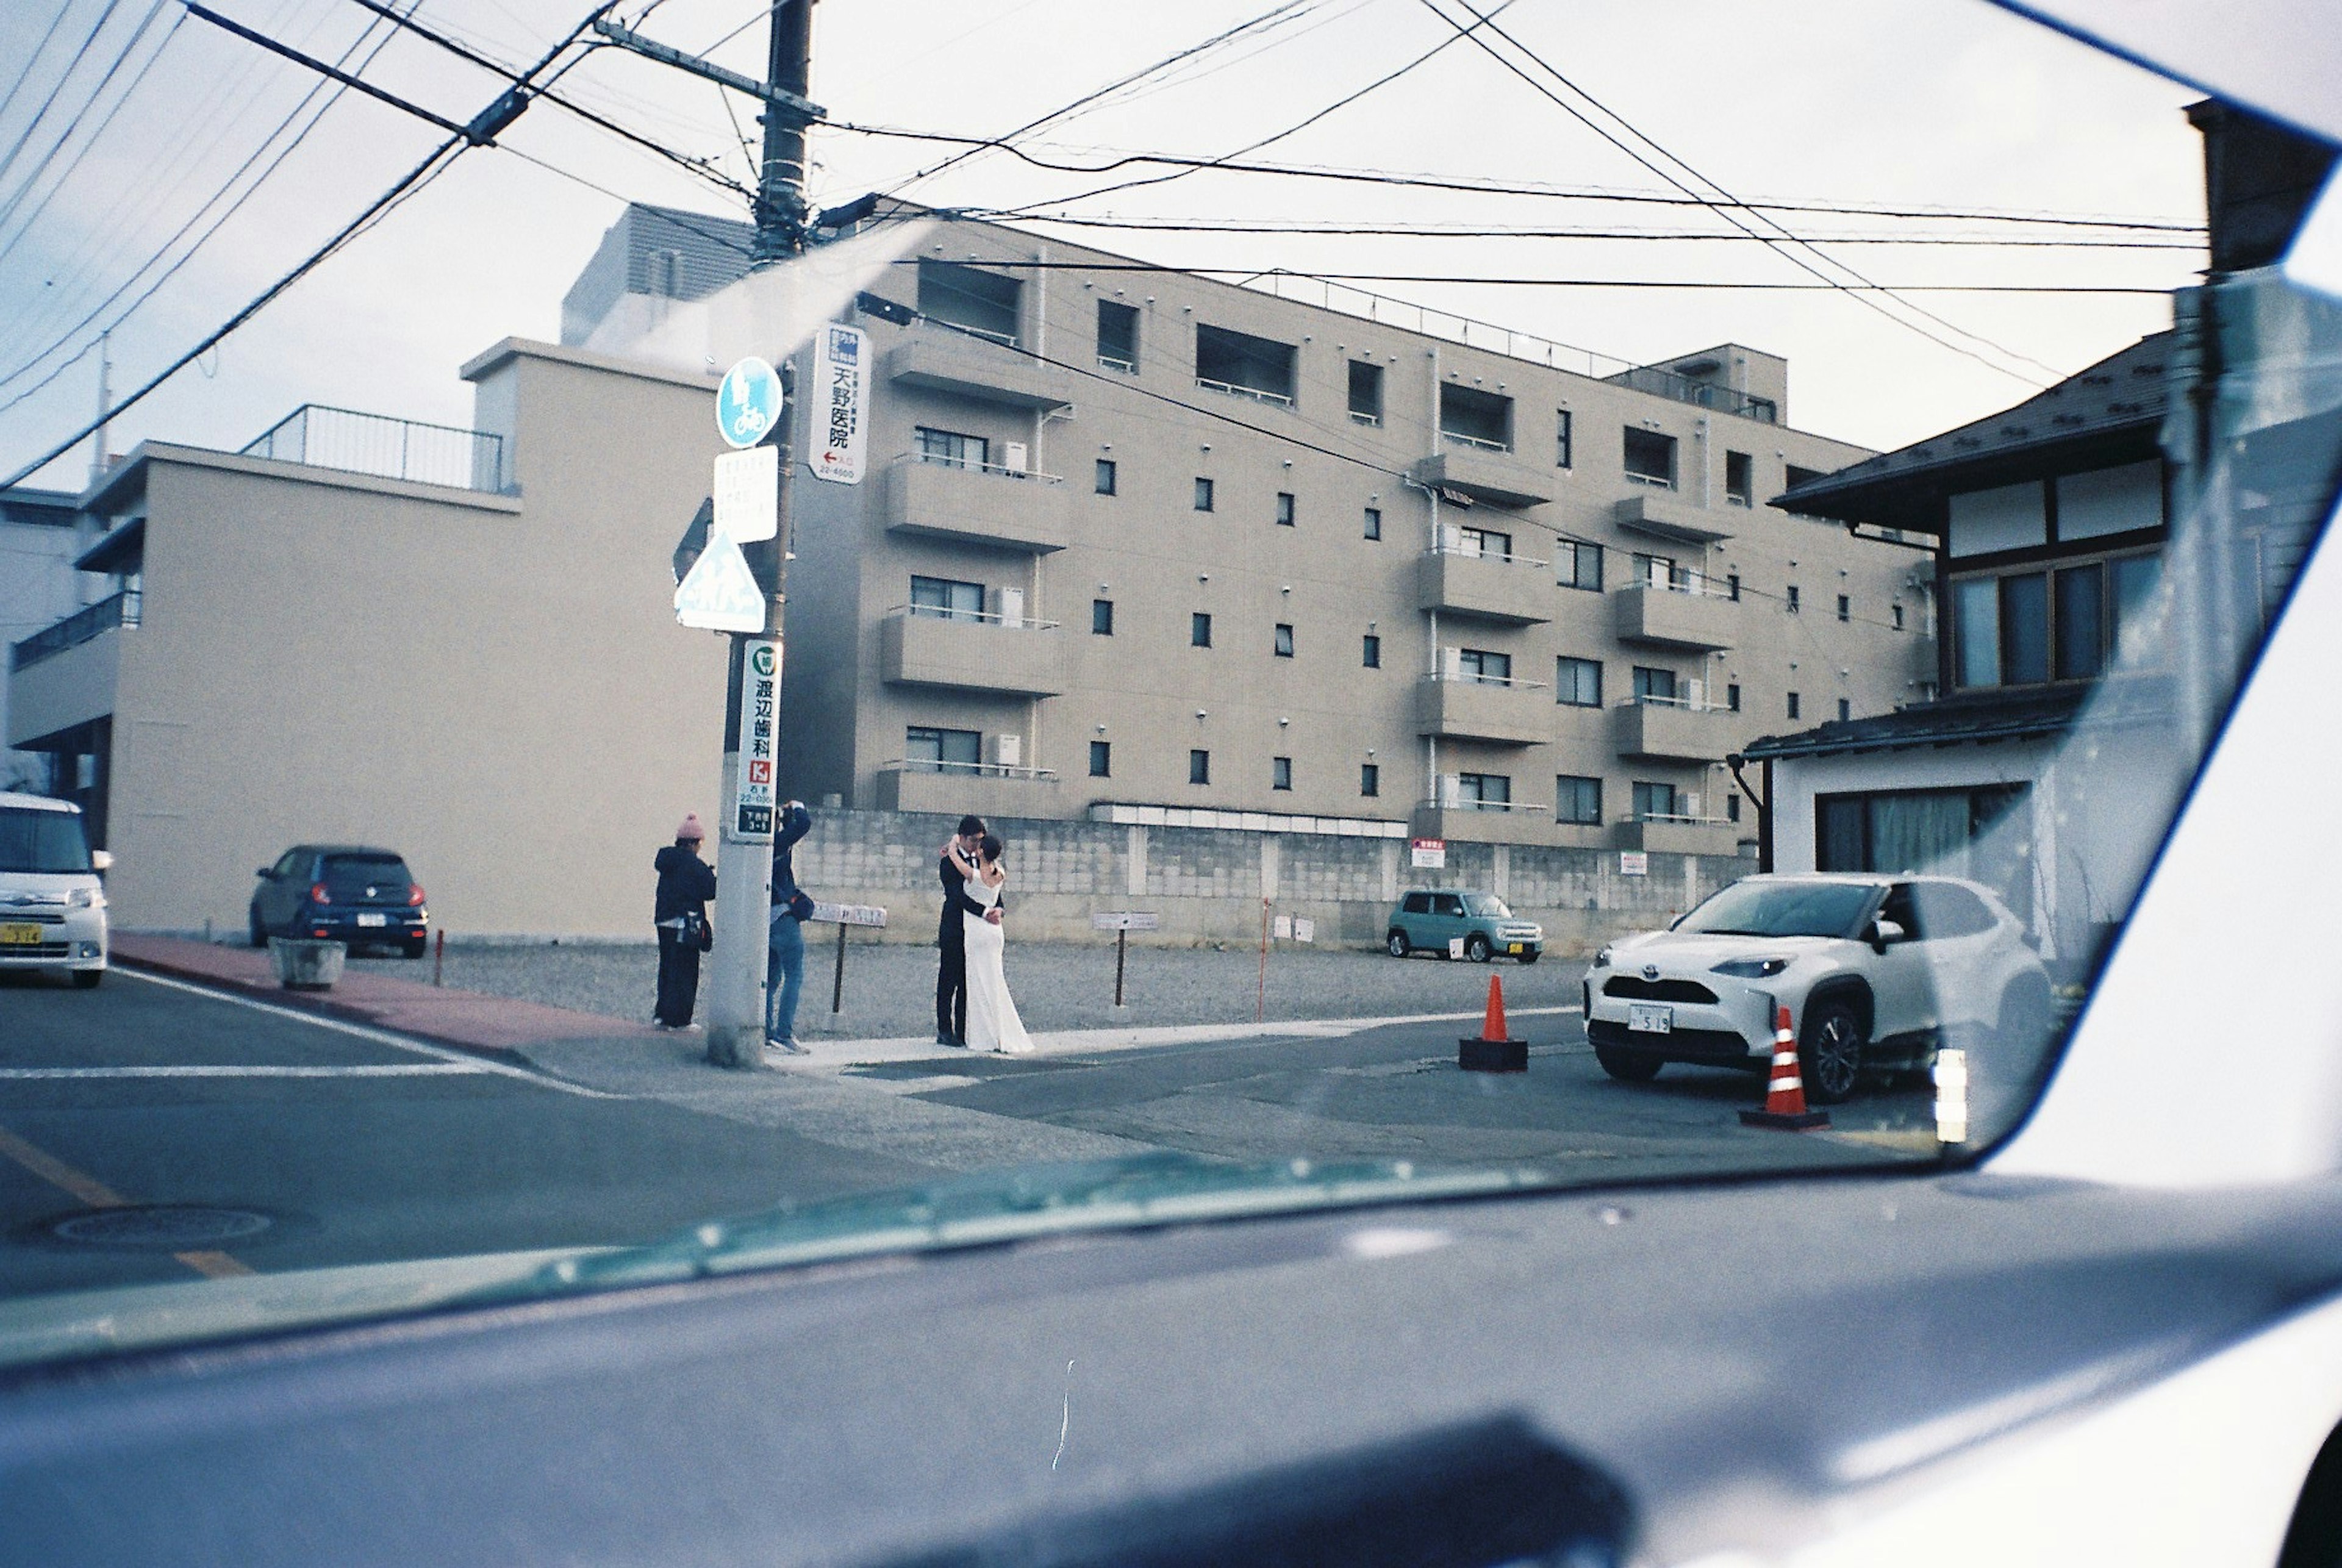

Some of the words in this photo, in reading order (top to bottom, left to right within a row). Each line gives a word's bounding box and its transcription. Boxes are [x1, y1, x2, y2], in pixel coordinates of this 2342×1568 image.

[829, 366, 851, 449] 天野医院
[753, 679, 773, 757] 渡辺歯科
